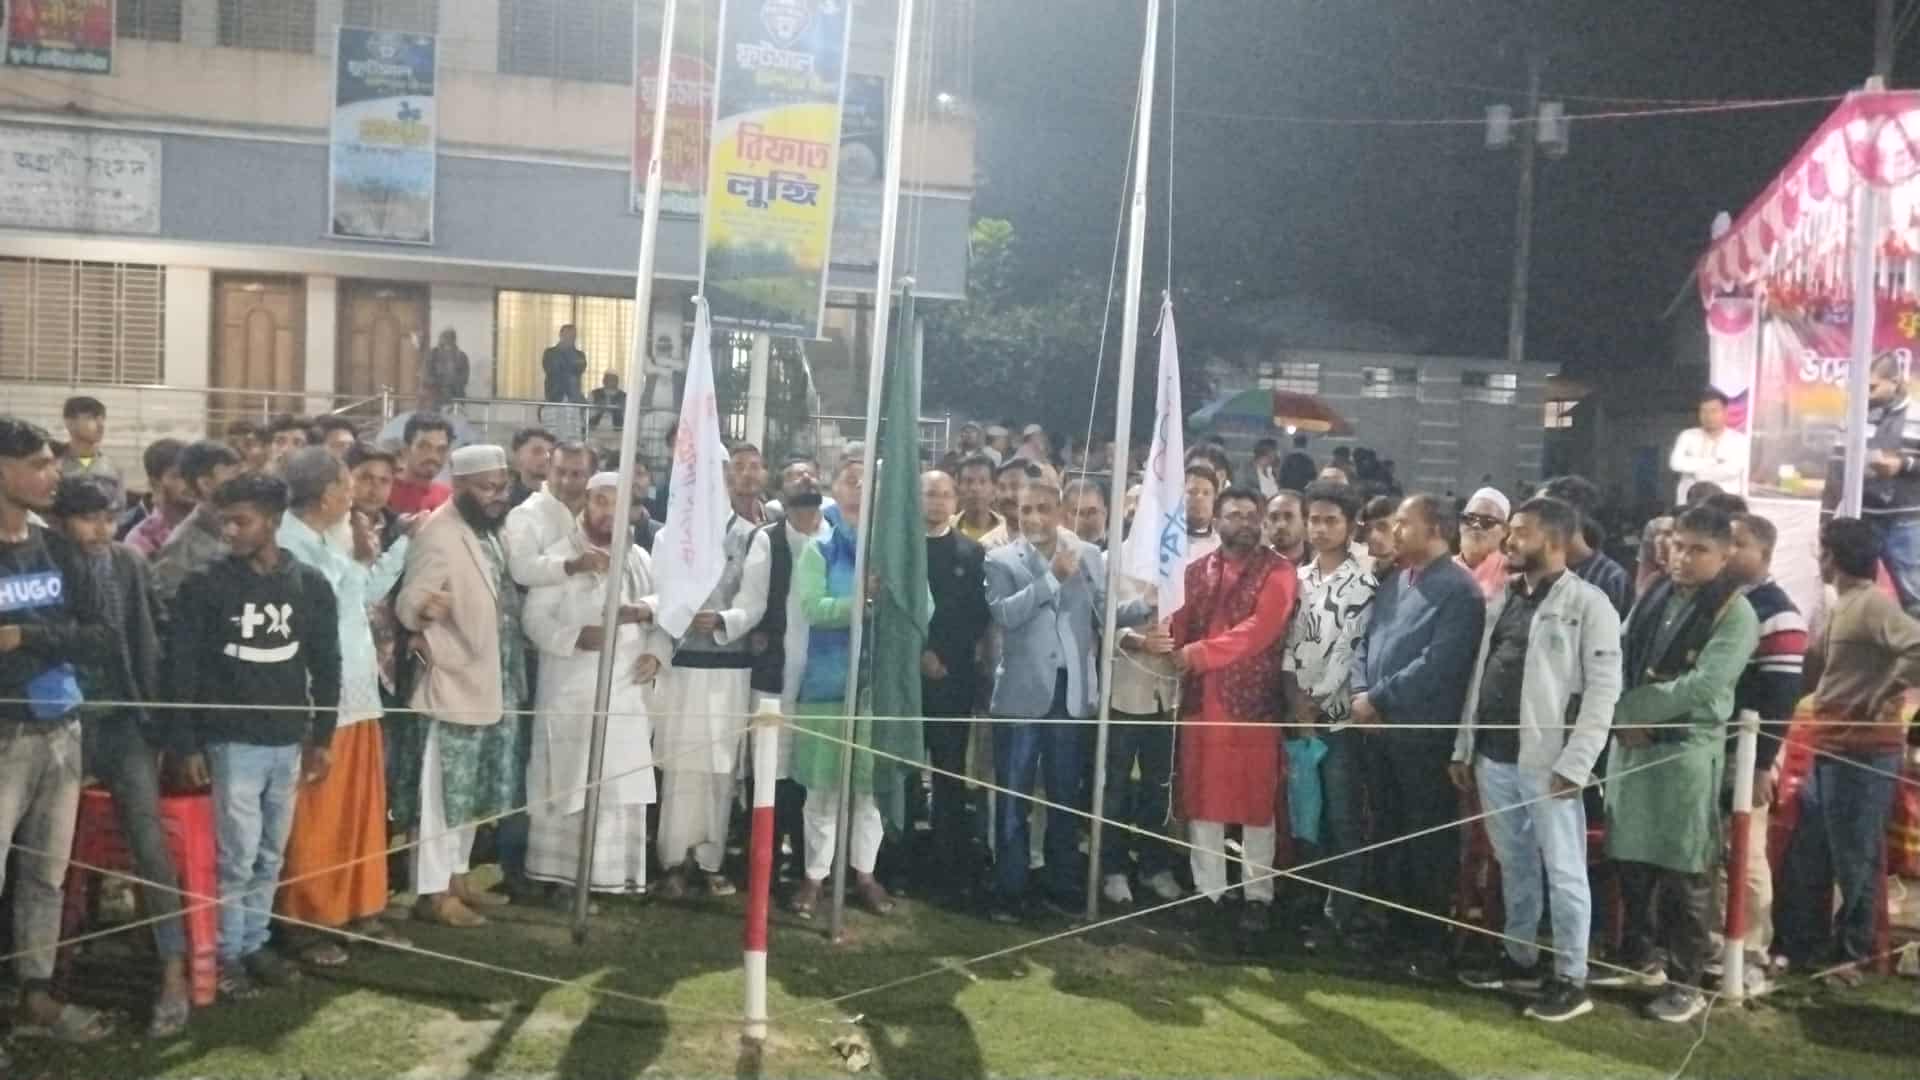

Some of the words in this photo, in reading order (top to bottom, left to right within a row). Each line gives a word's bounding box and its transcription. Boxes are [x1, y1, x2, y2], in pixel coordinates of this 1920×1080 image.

[736, 120, 832, 169] রিফাত
[725, 169, 821, 208] লুঙ্গি
[0, 577, 61, 604] HUGO
